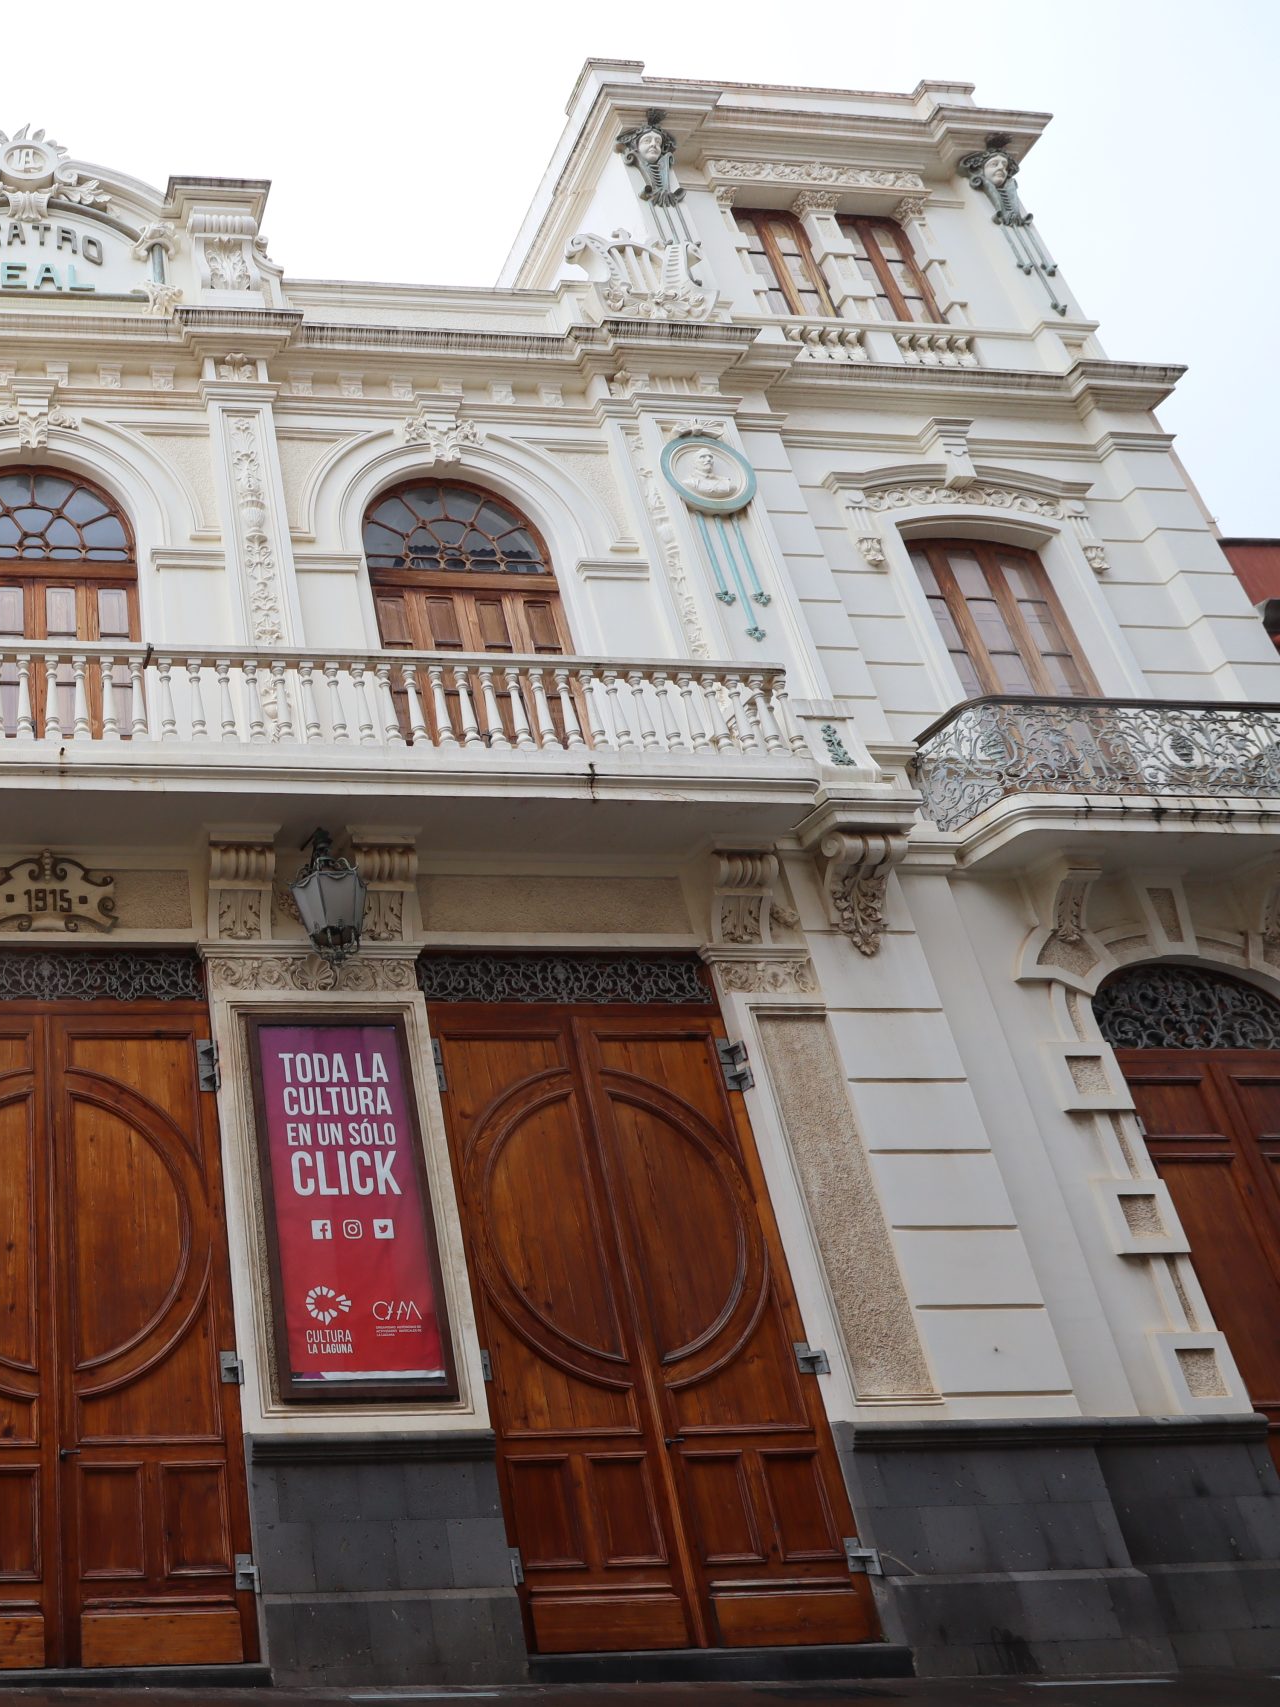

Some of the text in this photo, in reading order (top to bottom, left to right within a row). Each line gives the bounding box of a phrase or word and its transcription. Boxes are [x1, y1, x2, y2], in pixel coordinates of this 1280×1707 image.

[23, 888, 73, 912] 1915
[278, 1052, 389, 1083] TODA LA
[283, 1086, 392, 1116] CULTURA
[287, 1119, 397, 1146] EN UN SÓLO
[291, 1151, 402, 1196] CLICK
[306, 1329, 353, 1343] CULTURA
[308, 1343, 353, 1354] LA LAGUNA
